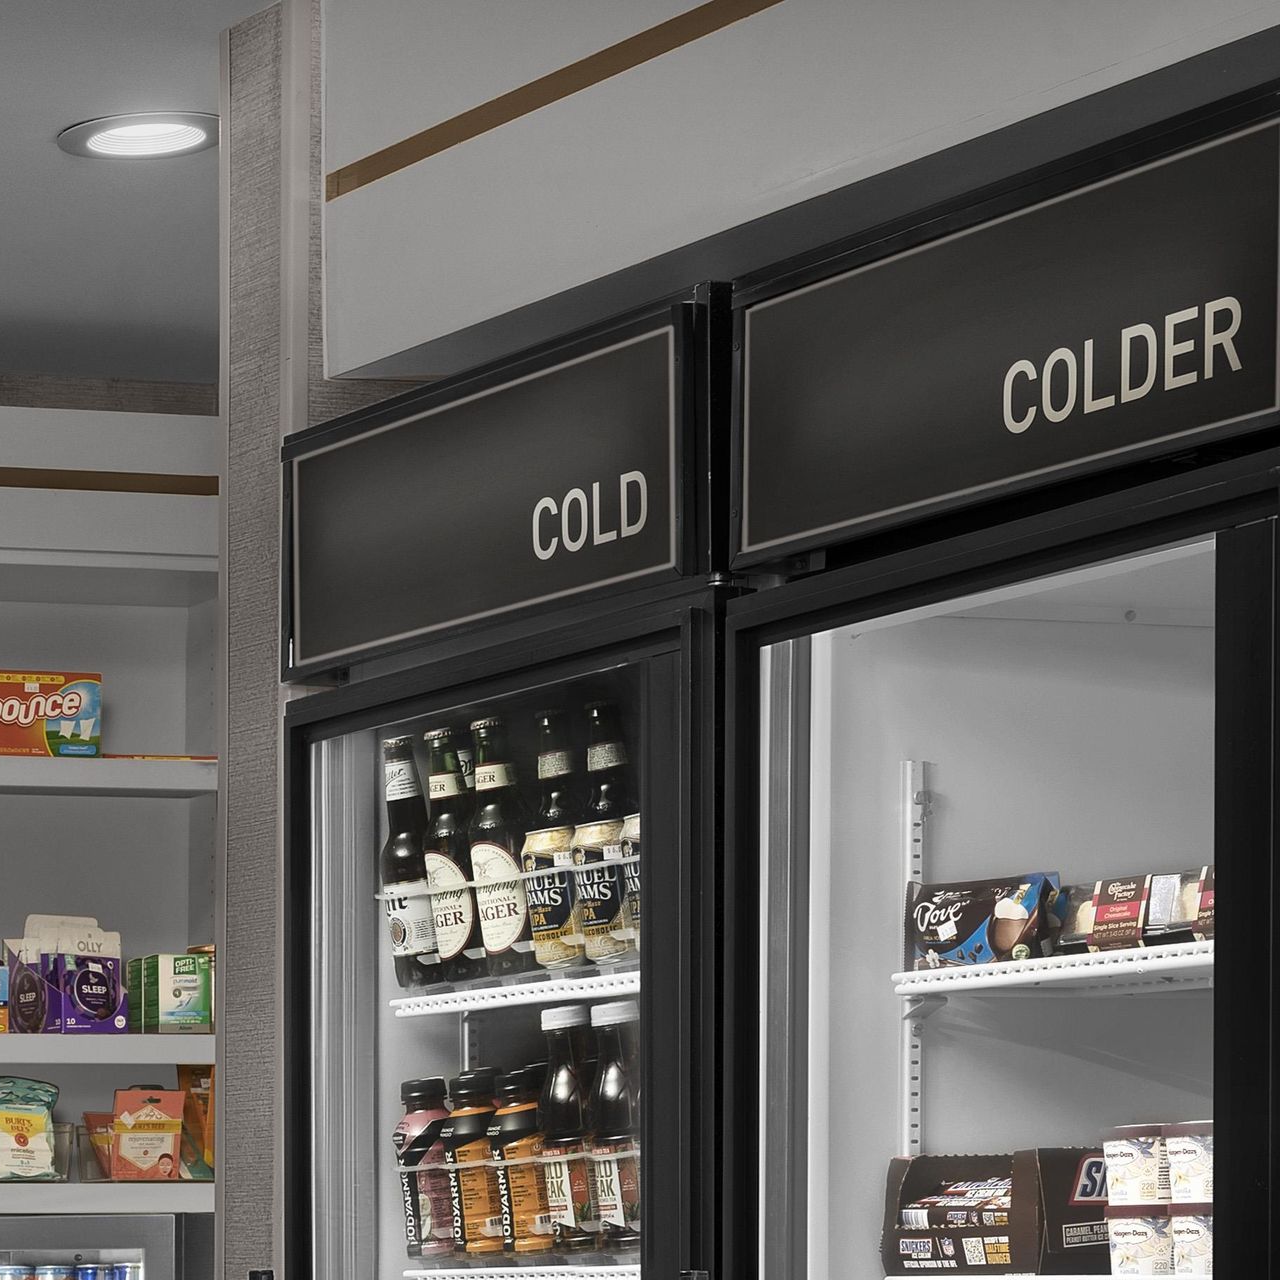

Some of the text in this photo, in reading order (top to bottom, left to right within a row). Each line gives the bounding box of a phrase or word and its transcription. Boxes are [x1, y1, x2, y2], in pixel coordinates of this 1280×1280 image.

[1002, 295, 1242, 434] COLDER
[532, 470, 648, 561] COLD
[913, 901, 963, 932] Dove
[1121, 921, 1136, 929] Serving
[78, 941, 102, 952] OLLY
[175, 965, 195, 974] FREE
[82, 985, 107, 993] SLEEP
[20, 993, 36, 1003] SLEEP
[5, 1117, 33, 1127] BURT'S
[11, 1125, 30, 1134] BEES
[900, 1240, 932, 1253] SNICKERS
